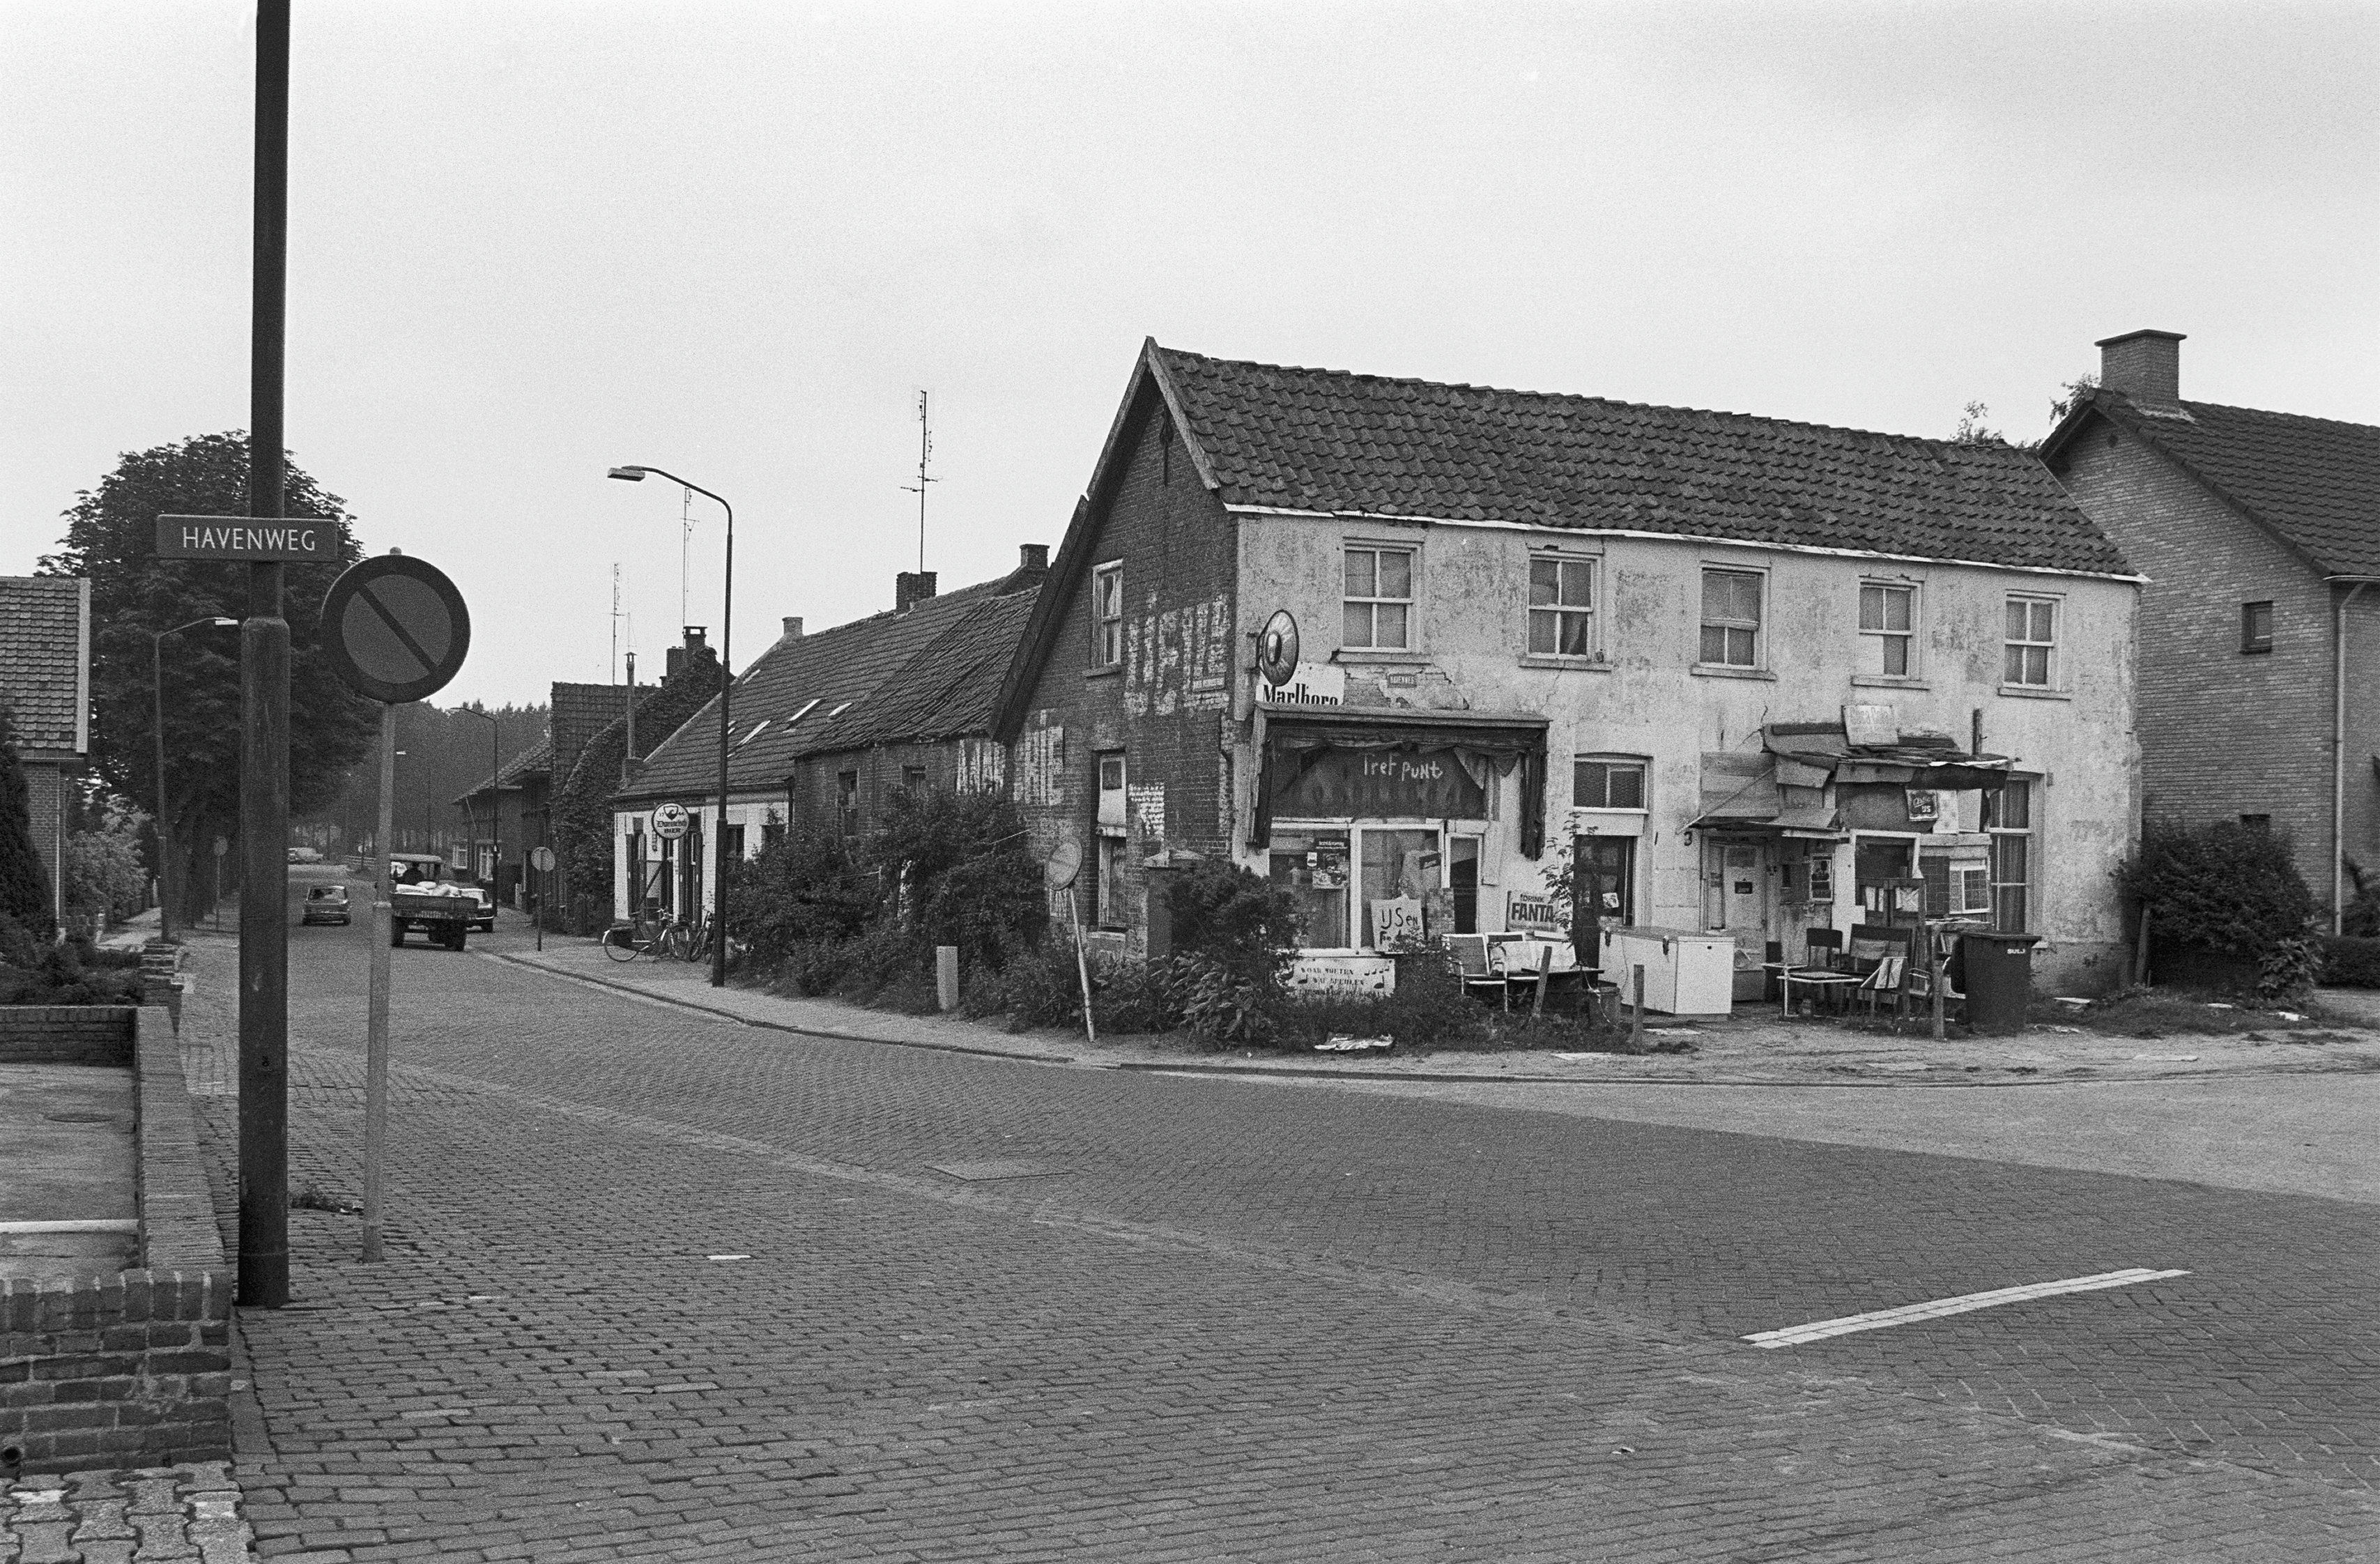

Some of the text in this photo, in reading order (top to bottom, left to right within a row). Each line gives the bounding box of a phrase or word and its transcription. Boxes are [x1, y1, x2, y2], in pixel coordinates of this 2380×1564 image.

[183, 527, 316, 551] HAVENWEG
[1522, 894, 1544, 903] DRINK
[1511, 902, 1555, 923] FANTA
